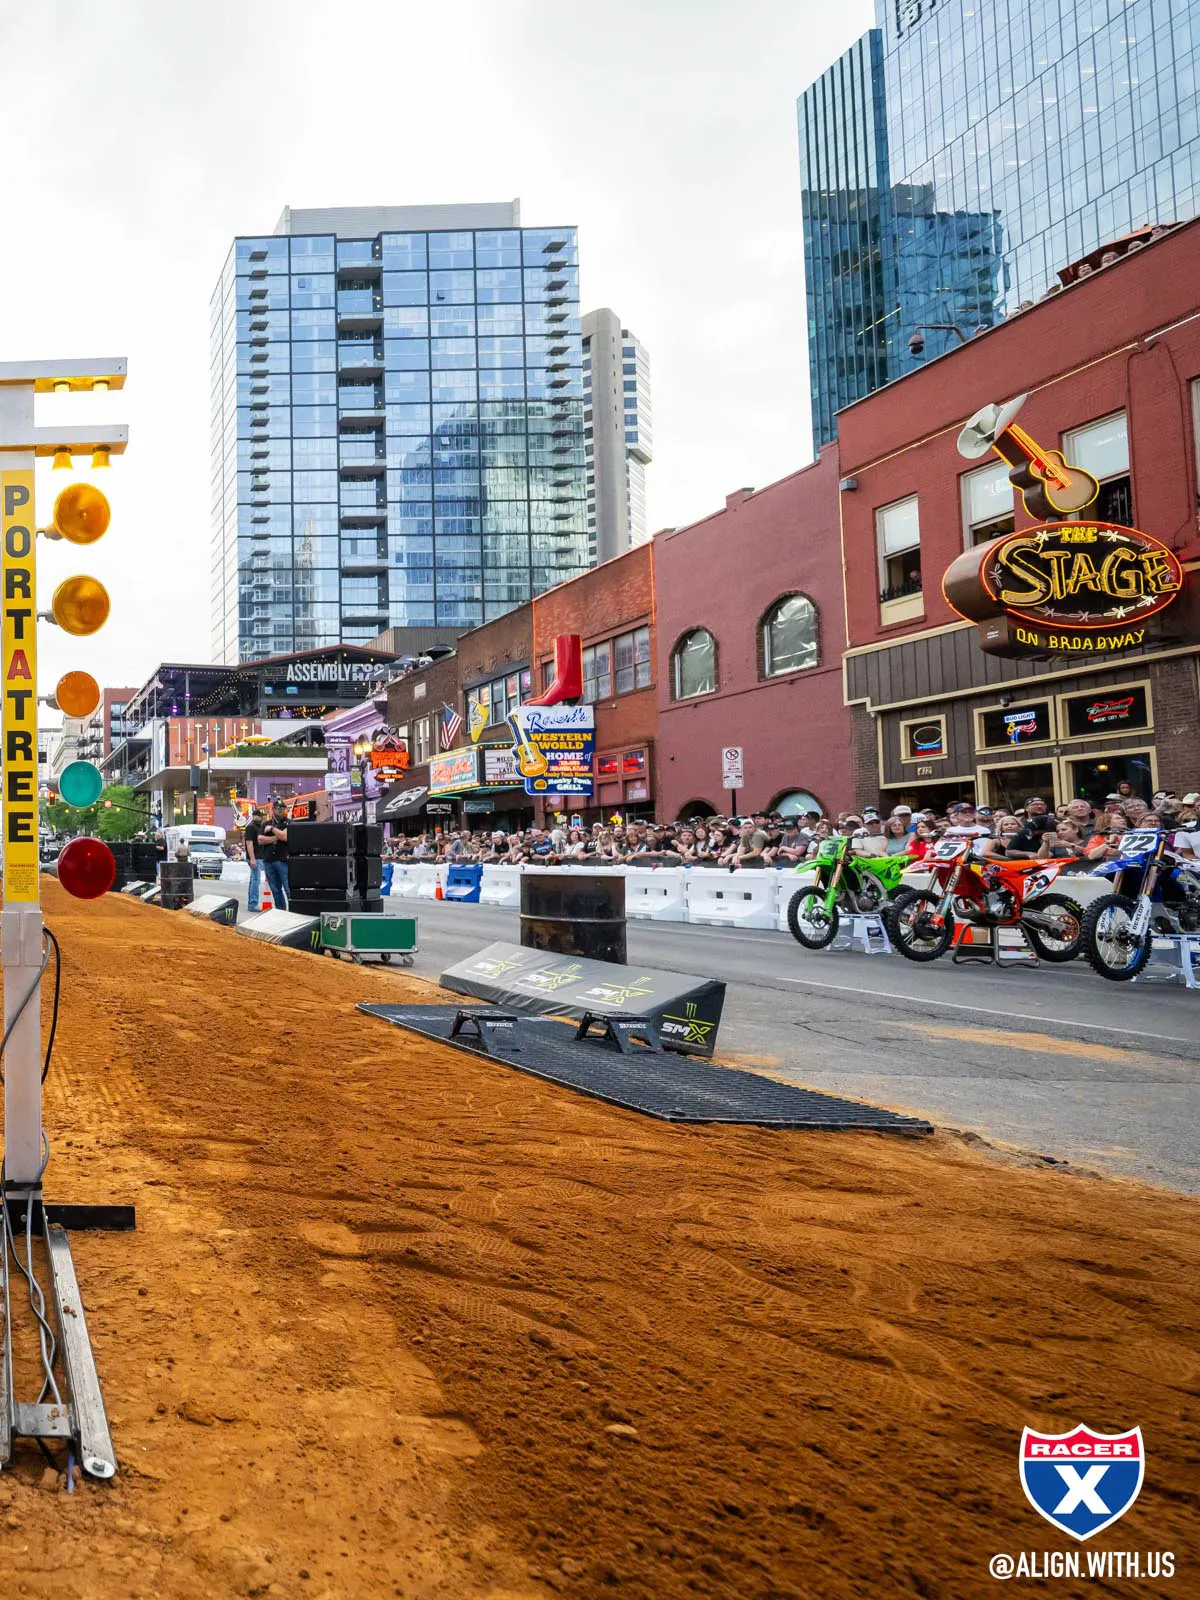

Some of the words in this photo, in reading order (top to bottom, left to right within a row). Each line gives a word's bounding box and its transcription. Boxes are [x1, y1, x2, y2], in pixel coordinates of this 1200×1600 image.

[1060, 527, 1098, 544] THE
[998, 537, 1181, 607] STAGE
[1016, 628, 1039, 647] ON
[1048, 629, 1145, 651] BROADWAY
[4, 484, 35, 843] PORTATREE
[286, 663, 351, 682] ASSEMBLY
[1018, 712, 1034, 720] LIGHT
[529, 732, 593, 741] WESTERN
[539, 741, 584, 750] WORLD
[546, 752, 583, 760] HOME
[584, 752, 592, 762] of
[936, 842, 965, 856] 5
[1122, 835, 1156, 852] 22
[1132, 903, 1146, 931] DUNLOP
[660, 1022, 711, 1044] SMX
